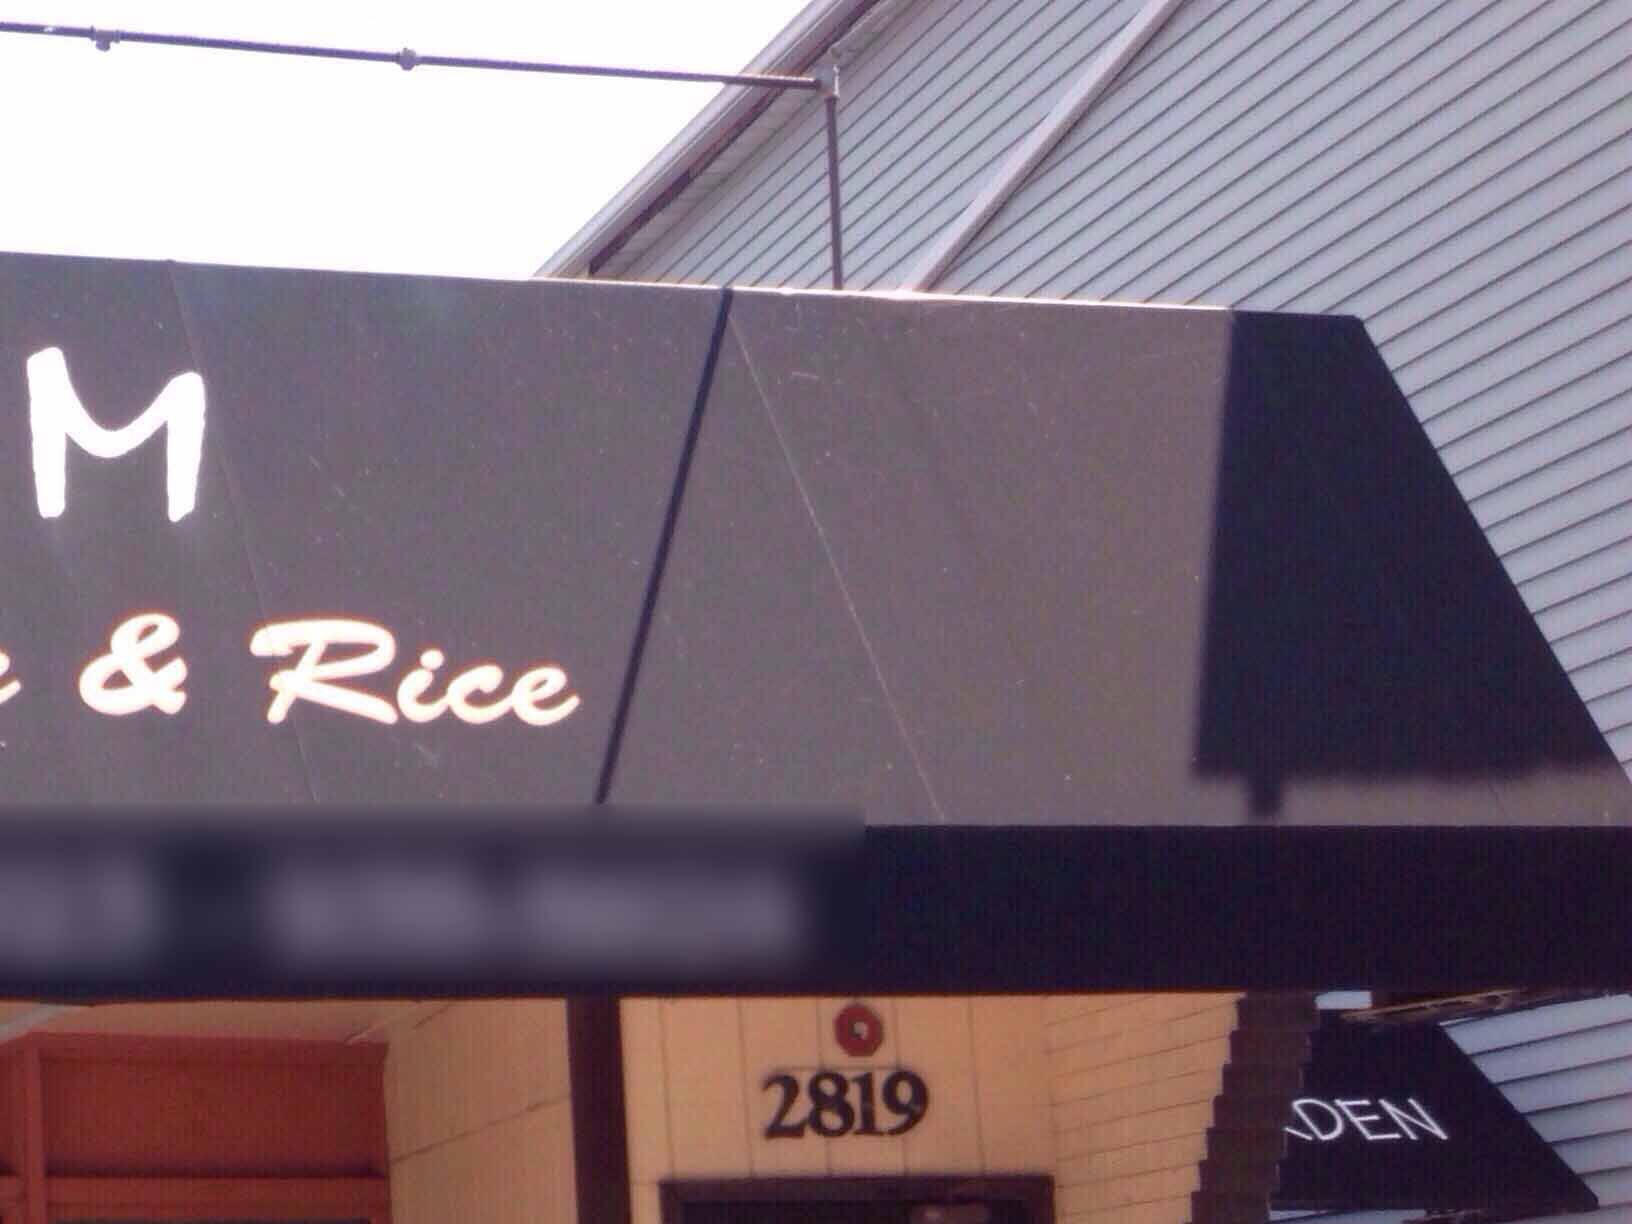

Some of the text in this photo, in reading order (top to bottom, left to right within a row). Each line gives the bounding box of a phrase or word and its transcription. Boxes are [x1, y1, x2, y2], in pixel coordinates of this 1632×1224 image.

[78, 612, 188, 718] &
[248, 618, 582, 728] Rice
[763, 1068, 930, 1140] 2819
